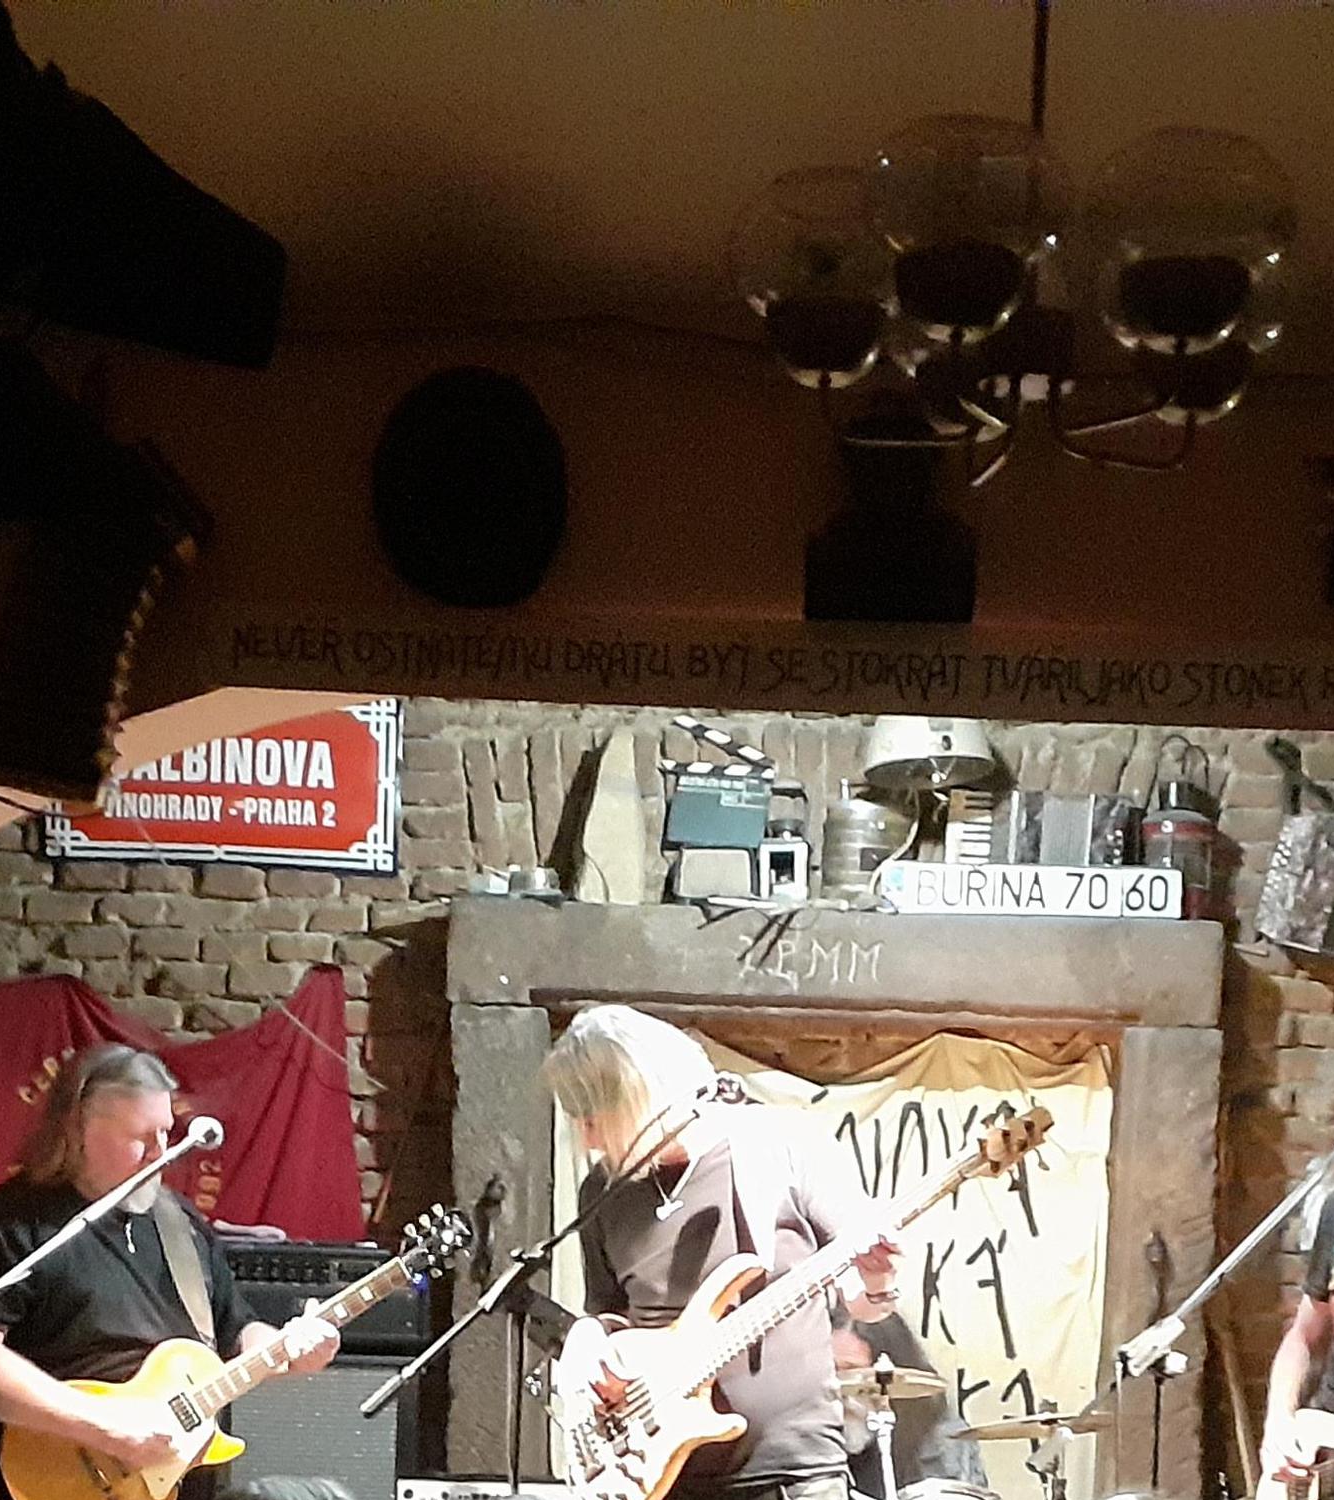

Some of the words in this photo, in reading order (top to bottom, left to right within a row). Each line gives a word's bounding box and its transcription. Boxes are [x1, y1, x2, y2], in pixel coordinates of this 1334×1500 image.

[762, 647, 808, 694] SE
[116, 737, 335, 790] LBINOVA
[244, 797, 317, 827] PRAHA
[321, 800, 337, 828] 2
[1065, 872, 1109, 910] 70
[1125, 873, 1169, 912] 60
